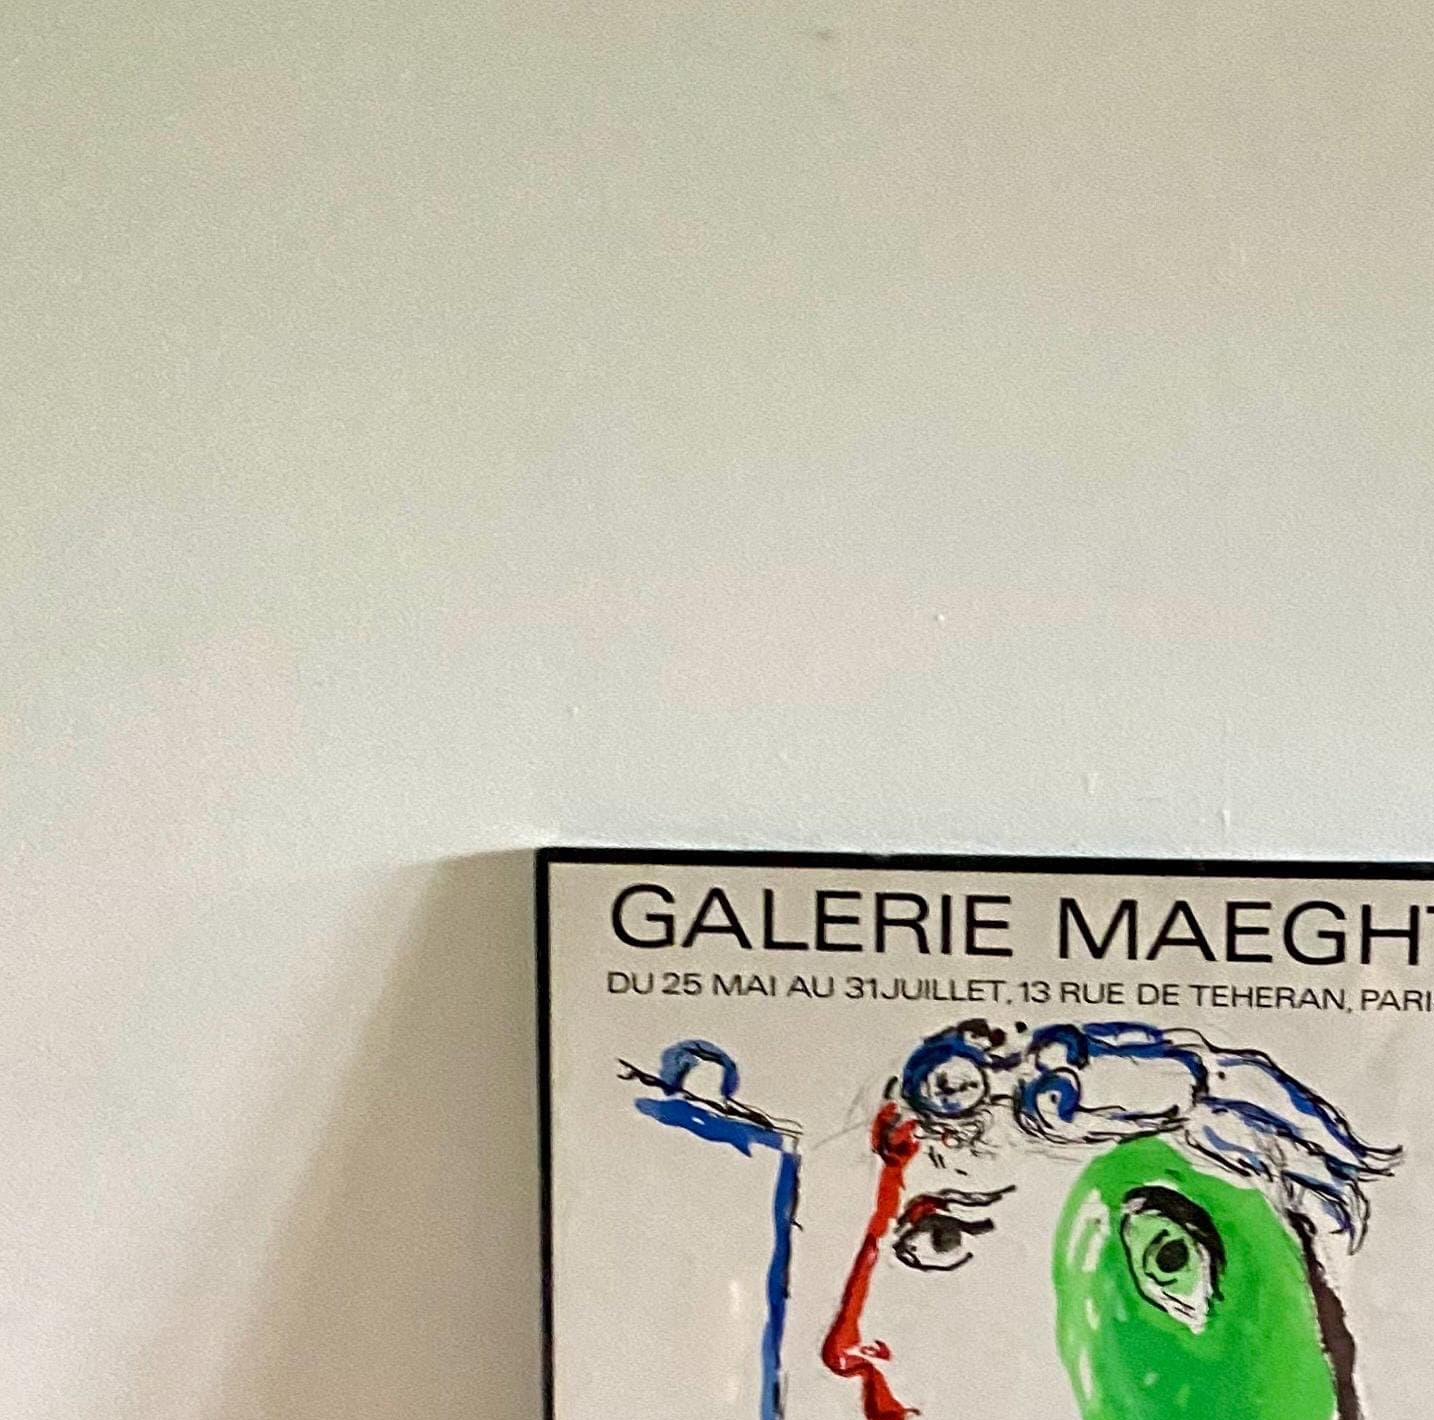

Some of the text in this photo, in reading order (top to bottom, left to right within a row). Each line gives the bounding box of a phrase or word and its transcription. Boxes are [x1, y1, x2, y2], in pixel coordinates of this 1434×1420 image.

[611, 883, 1014, 958] GALERIE
[607, 971, 654, 996] DU
[662, 972, 702, 997] 25
[713, 974, 776, 998] MAI
[788, 975, 835, 999] AU
[1022, 981, 1051, 1003] 13
[1060, 982, 1126, 1006] RUE
[1138, 984, 1180, 1007] DE
